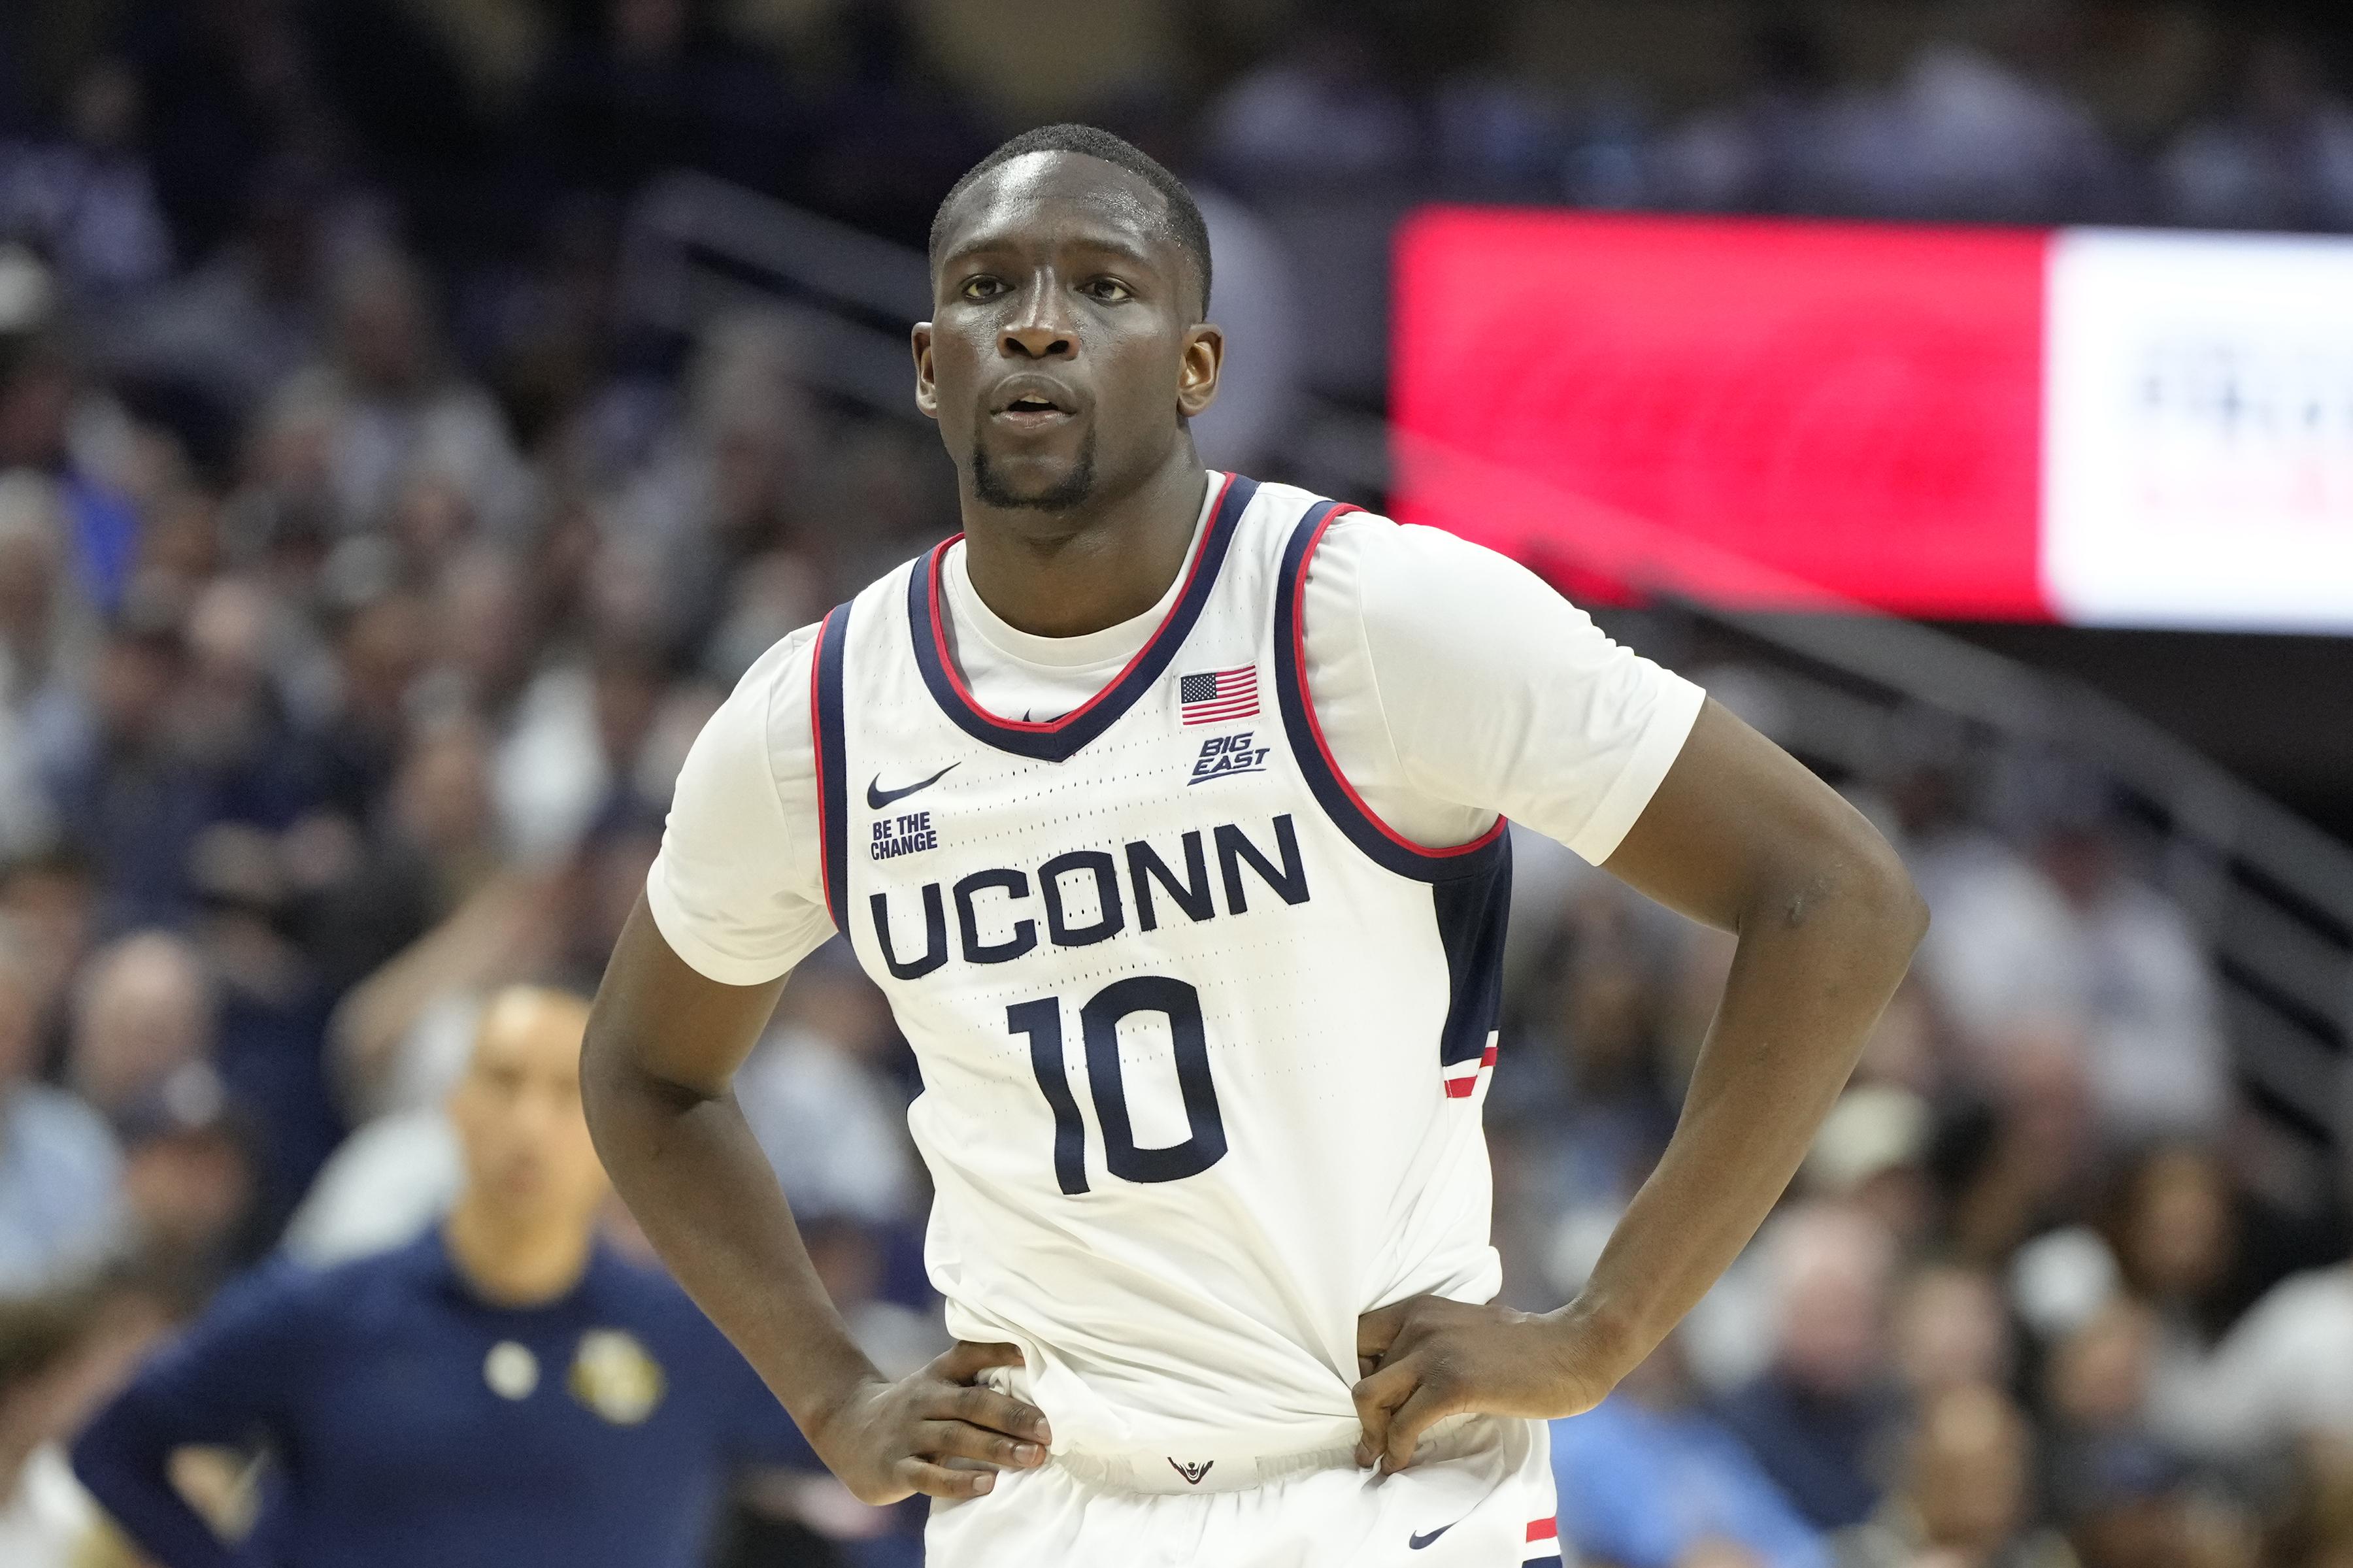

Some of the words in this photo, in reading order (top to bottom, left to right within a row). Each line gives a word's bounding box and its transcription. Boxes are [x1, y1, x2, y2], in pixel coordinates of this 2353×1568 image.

[1199, 731, 1254, 758] BIG
[1192, 748, 1270, 776] EAST
[873, 819, 892, 841] BE
[896, 811, 930, 835] THE
[871, 830, 938, 860] CHANGE
[869, 814, 1310, 980] UCONN
[1006, 976, 1228, 1195] 10
